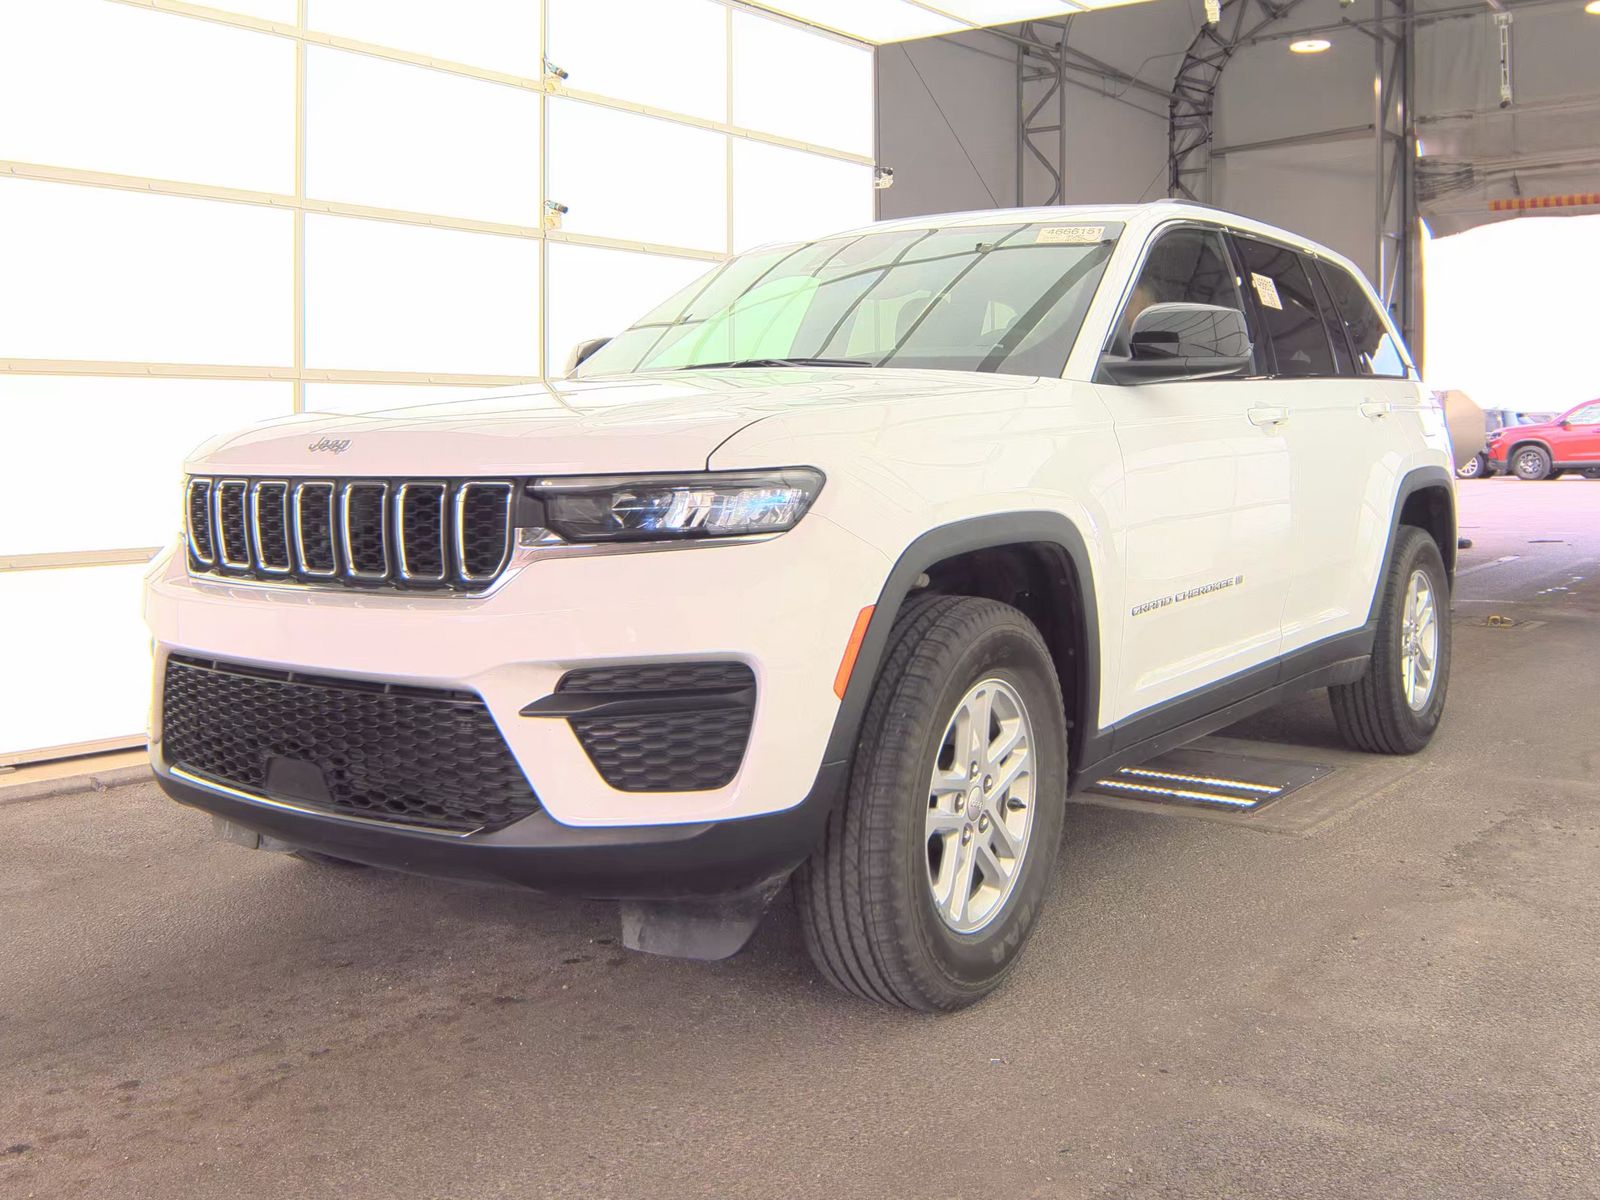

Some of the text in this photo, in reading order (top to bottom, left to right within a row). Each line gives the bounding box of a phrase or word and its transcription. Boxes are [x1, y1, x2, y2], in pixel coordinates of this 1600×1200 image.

[308, 435, 353, 455] Jeep
[1131, 577, 1235, 617] GRAND CHEROKEE
